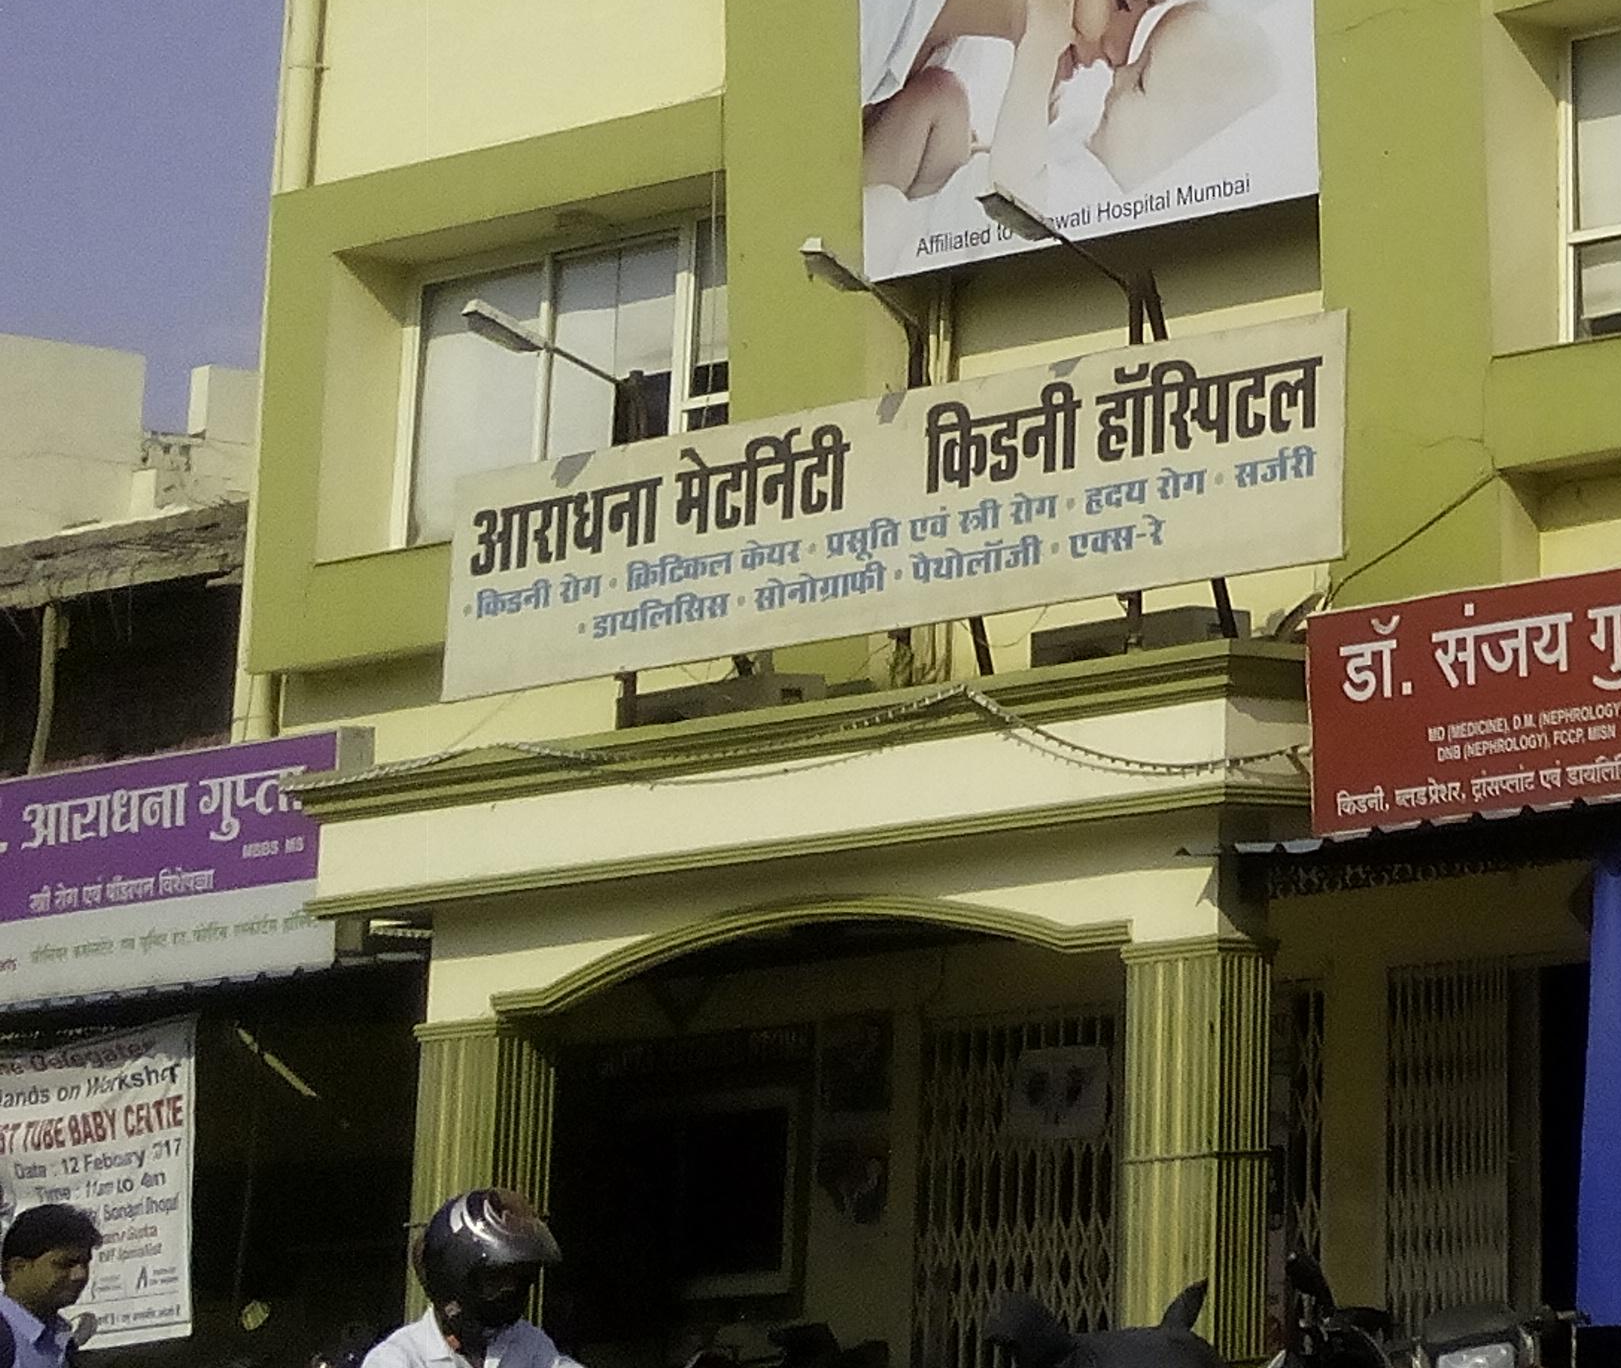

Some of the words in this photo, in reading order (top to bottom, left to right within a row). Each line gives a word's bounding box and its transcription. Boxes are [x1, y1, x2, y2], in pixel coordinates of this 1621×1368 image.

[915, 225, 992, 257] Affiliated
[1098, 190, 1171, 222] Hospital
[1177, 172, 1251, 206] Mumbai
[470, 476, 663, 577] आराधना
[674, 424, 851, 535] मेटर्निटी
[926, 381, 1082, 495] किडनी
[1095, 356, 1324, 462] हॉस्पिटल
[476, 577, 551, 619] किडनी
[560, 572, 602, 604] रोग
[741, 539, 802, 572] केयर
[825, 517, 902, 562] प्रसूति
[909, 505, 950, 543] एवं
[958, 498, 1002, 534] स्त्री
[1009, 492, 1058, 525] रोग
[1156, 466, 1207, 500] रोग
[1234, 445, 1318, 489] सर्जरी
[592, 591, 731, 639] डायलिसिस
[755, 561, 887, 612] सोनोग्राफी
[1339, 615, 1413, 702] डॉ.
[1432, 603, 1573, 688] संजय
[1428, 726, 1445, 742] MD
[1437, 744, 1461, 762] DNB
[1539, 759, 1562, 789] एवं
[21, 782, 189, 850] आराधना
[57, 1082, 82, 1103] on
[23, 1115, 66, 1153] TUBE
[68, 1107, 118, 1147] BABY
[61, 1155, 80, 1175] 12
